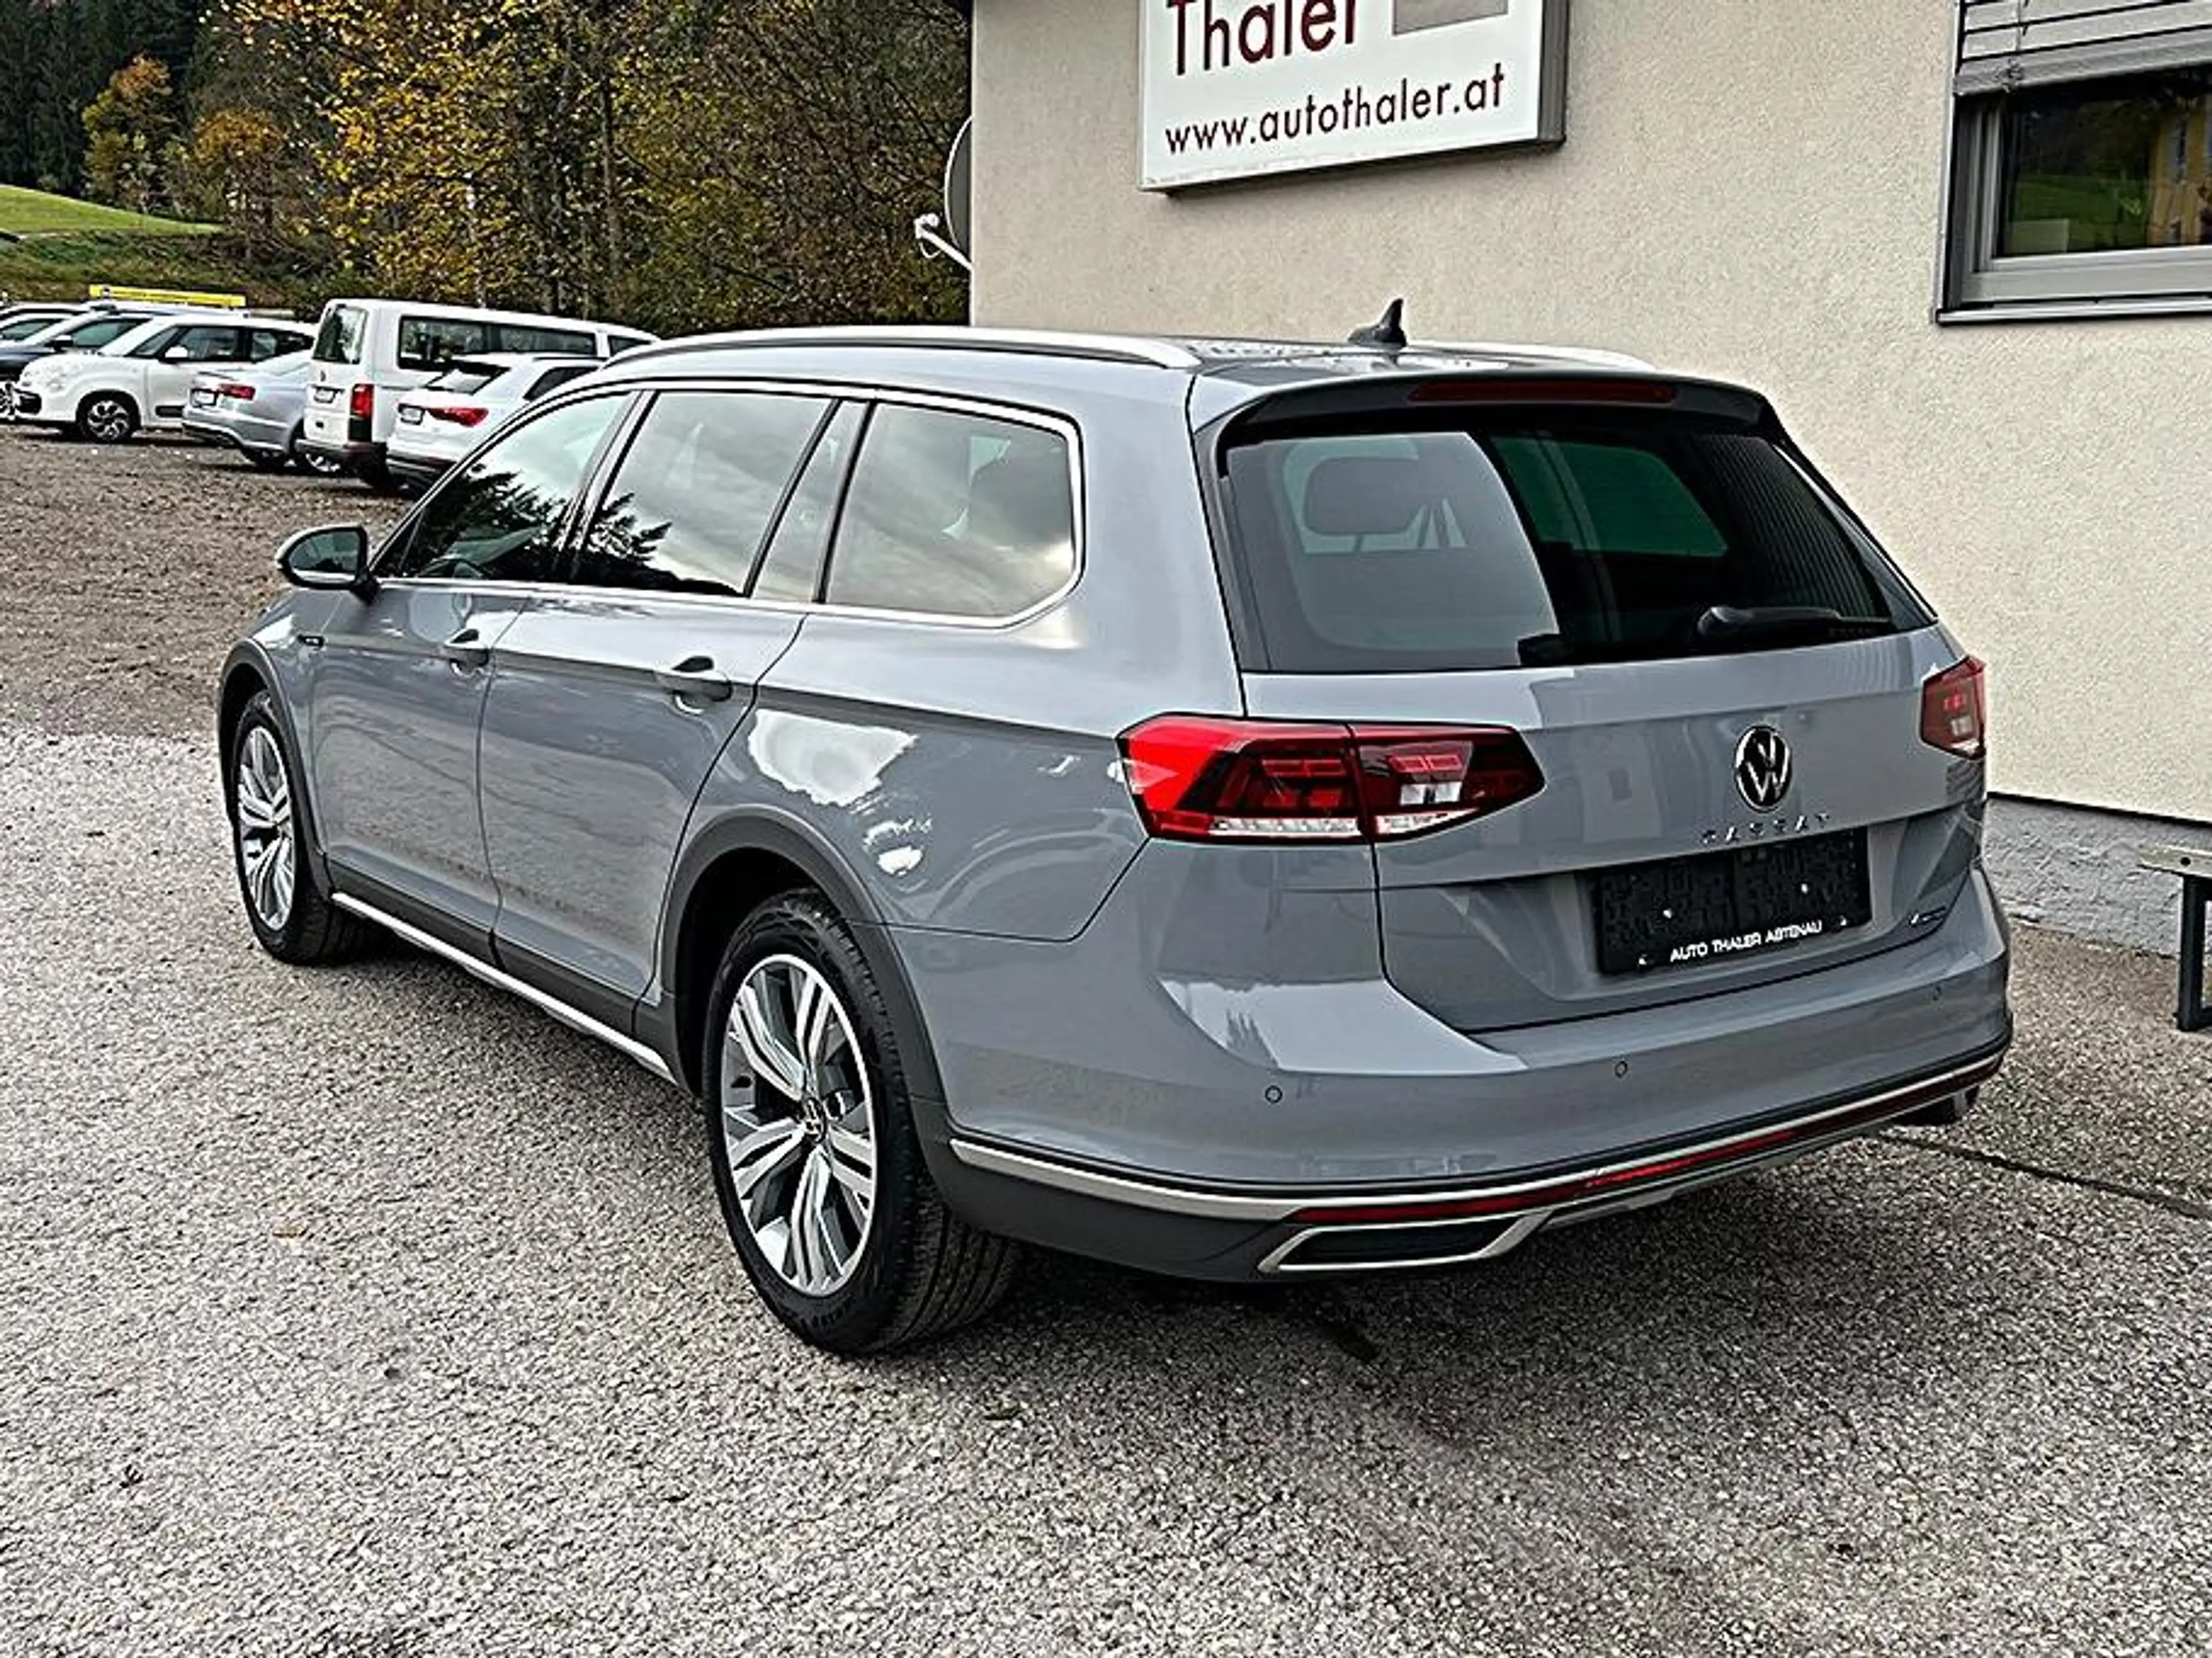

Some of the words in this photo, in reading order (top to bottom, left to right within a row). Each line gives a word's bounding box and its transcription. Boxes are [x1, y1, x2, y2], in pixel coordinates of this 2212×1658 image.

[1165, 62, 1504, 154] www.autothaler.at
[1671, 942, 1708, 962] AUTO
[1711, 932, 1762, 953] THALER
